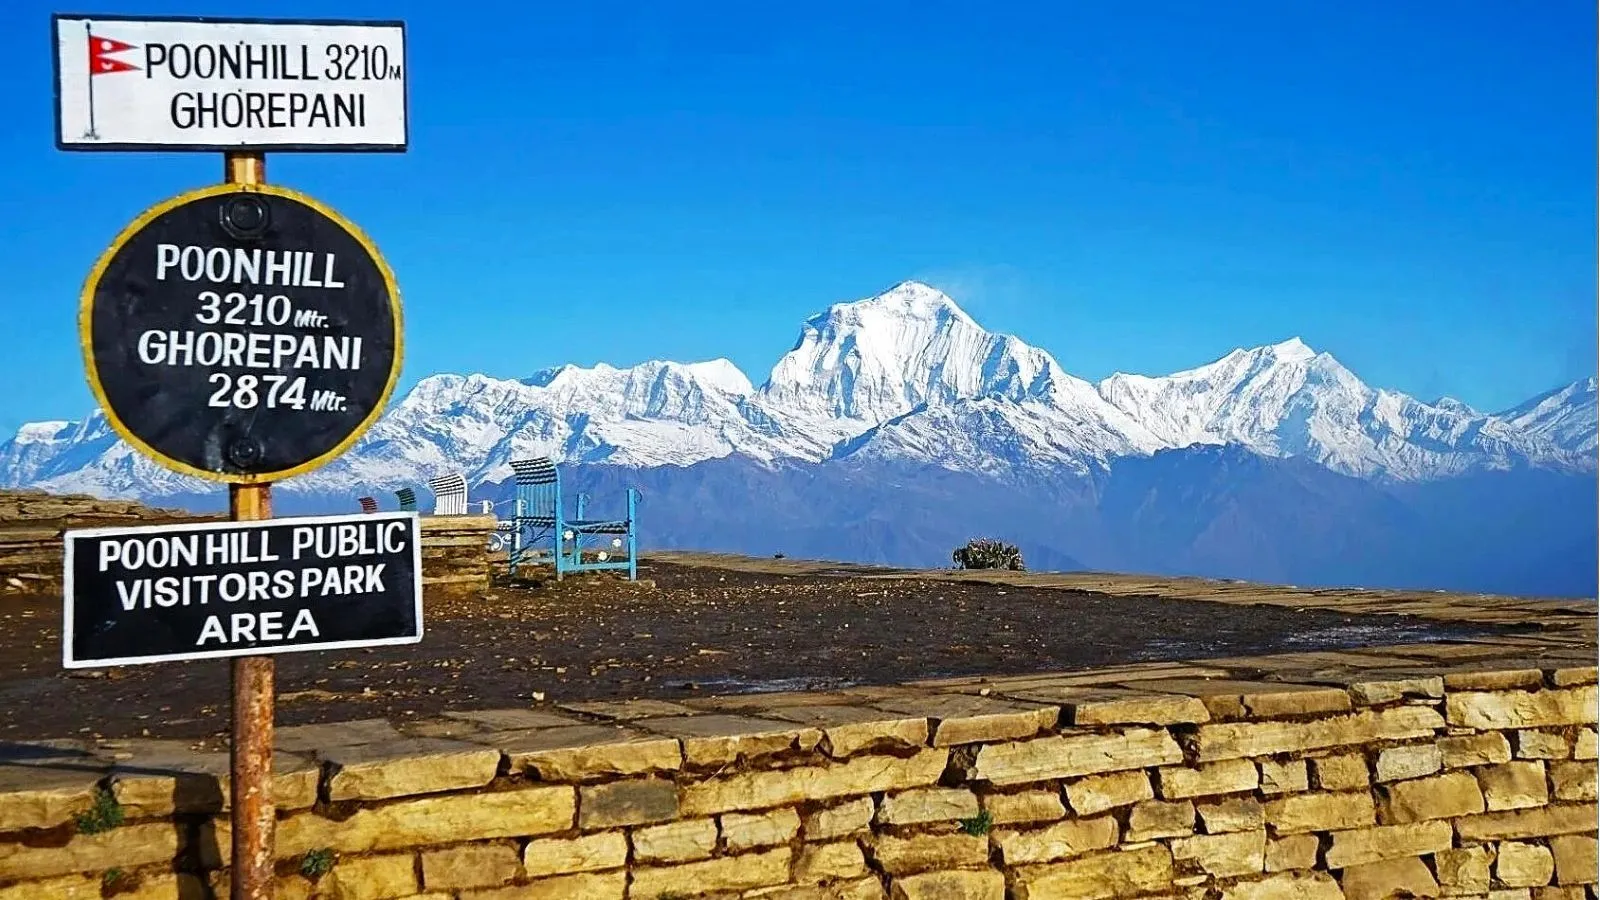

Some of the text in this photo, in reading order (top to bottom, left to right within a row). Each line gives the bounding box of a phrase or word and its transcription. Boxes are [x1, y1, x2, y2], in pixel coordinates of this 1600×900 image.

[145, 43, 319, 81] POONHILL
[170, 92, 366, 129] GHOREPANI
[195, 291, 330, 329] 3210 Mtr.
[137, 329, 363, 370] GHOREPANI
[207, 372, 348, 413] 2874 Mtr.
[292, 521, 407, 560] PUBLIC
[115, 563, 386, 611] VISITORS PARK
[195, 608, 320, 646] AREA
